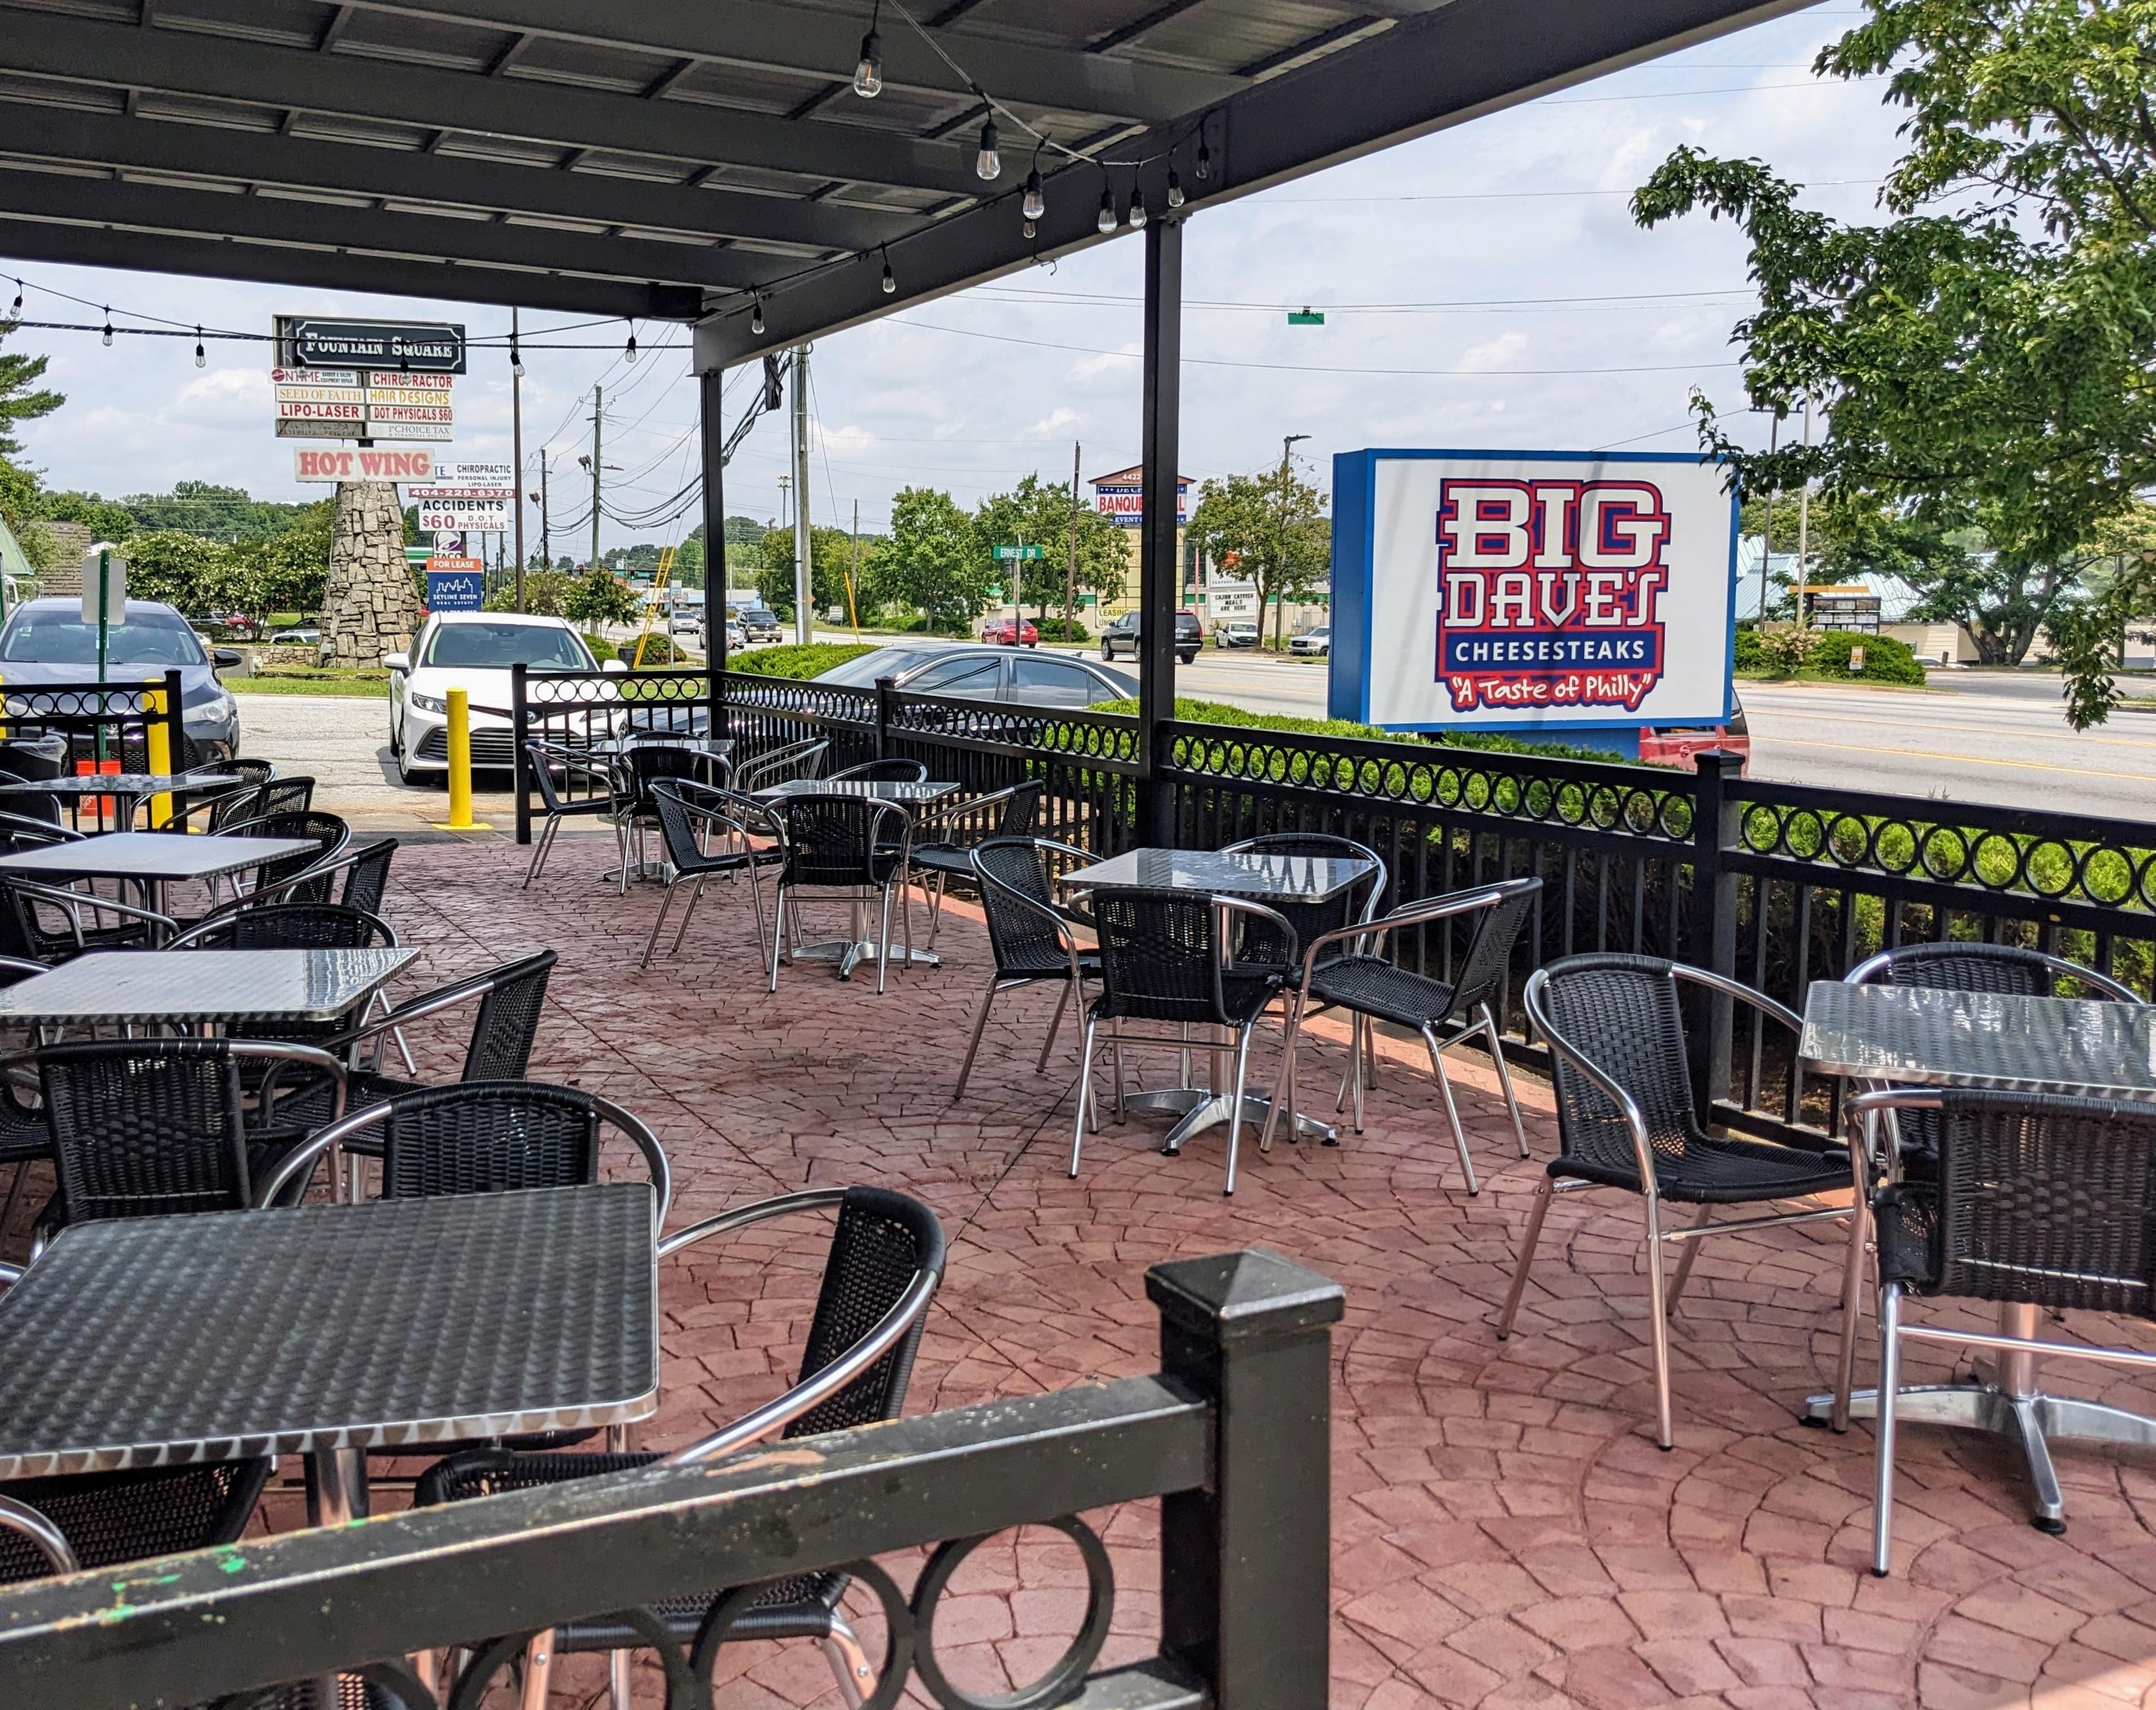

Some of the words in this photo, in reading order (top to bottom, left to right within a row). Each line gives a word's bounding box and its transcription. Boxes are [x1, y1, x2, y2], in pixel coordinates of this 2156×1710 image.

[373, 373, 453, 388] CHIRORACTOR
[280, 388, 308, 399] SEED
[309, 390, 324, 400] OF
[328, 390, 362, 401] FAITH
[370, 390, 396, 403] HAIR
[399, 389, 450, 405] DESIGNS
[281, 404, 359, 418] LIPO-LASER
[374, 407, 390, 419] DOT
[393, 408, 437, 420] PHYSICALS
[438, 409, 453, 421] $60
[300, 452, 353, 475] HOT
[359, 453, 430, 476] WING
[457, 464, 511, 473] CHIROPRACTIC
[422, 500, 504, 511] ACCIDENTS
[1099, 496, 1142, 512] BANQUE
[423, 514, 455, 529] $60
[1445, 488, 1662, 568] BIG
[1000, 548, 1023, 558] ERNEST
[1027, 548, 1035, 558] DR
[1445, 571, 1660, 628] DAVE'S
[1455, 641, 1645, 661] CHEESESTEAKS
[1478, 679, 1547, 700] Taste
[1555, 676, 1579, 697] of
